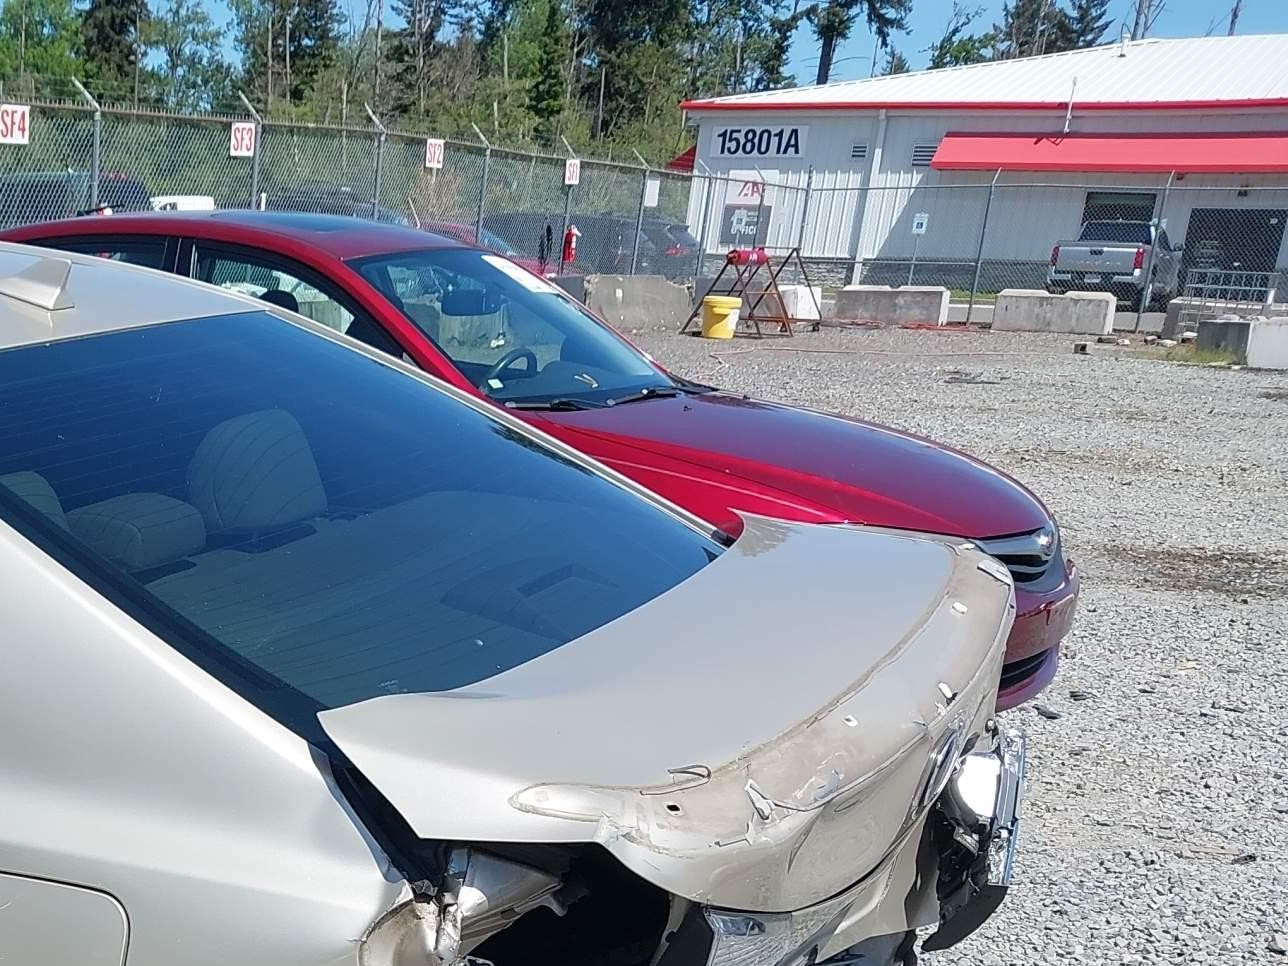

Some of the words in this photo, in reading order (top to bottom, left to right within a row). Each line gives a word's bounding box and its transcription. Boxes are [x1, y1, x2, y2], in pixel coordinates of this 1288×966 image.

[0, 109, 26, 139] SF4
[233, 127, 254, 152] SF3
[717, 127, 800, 155] 15801A
[427, 143, 443, 164] SF2
